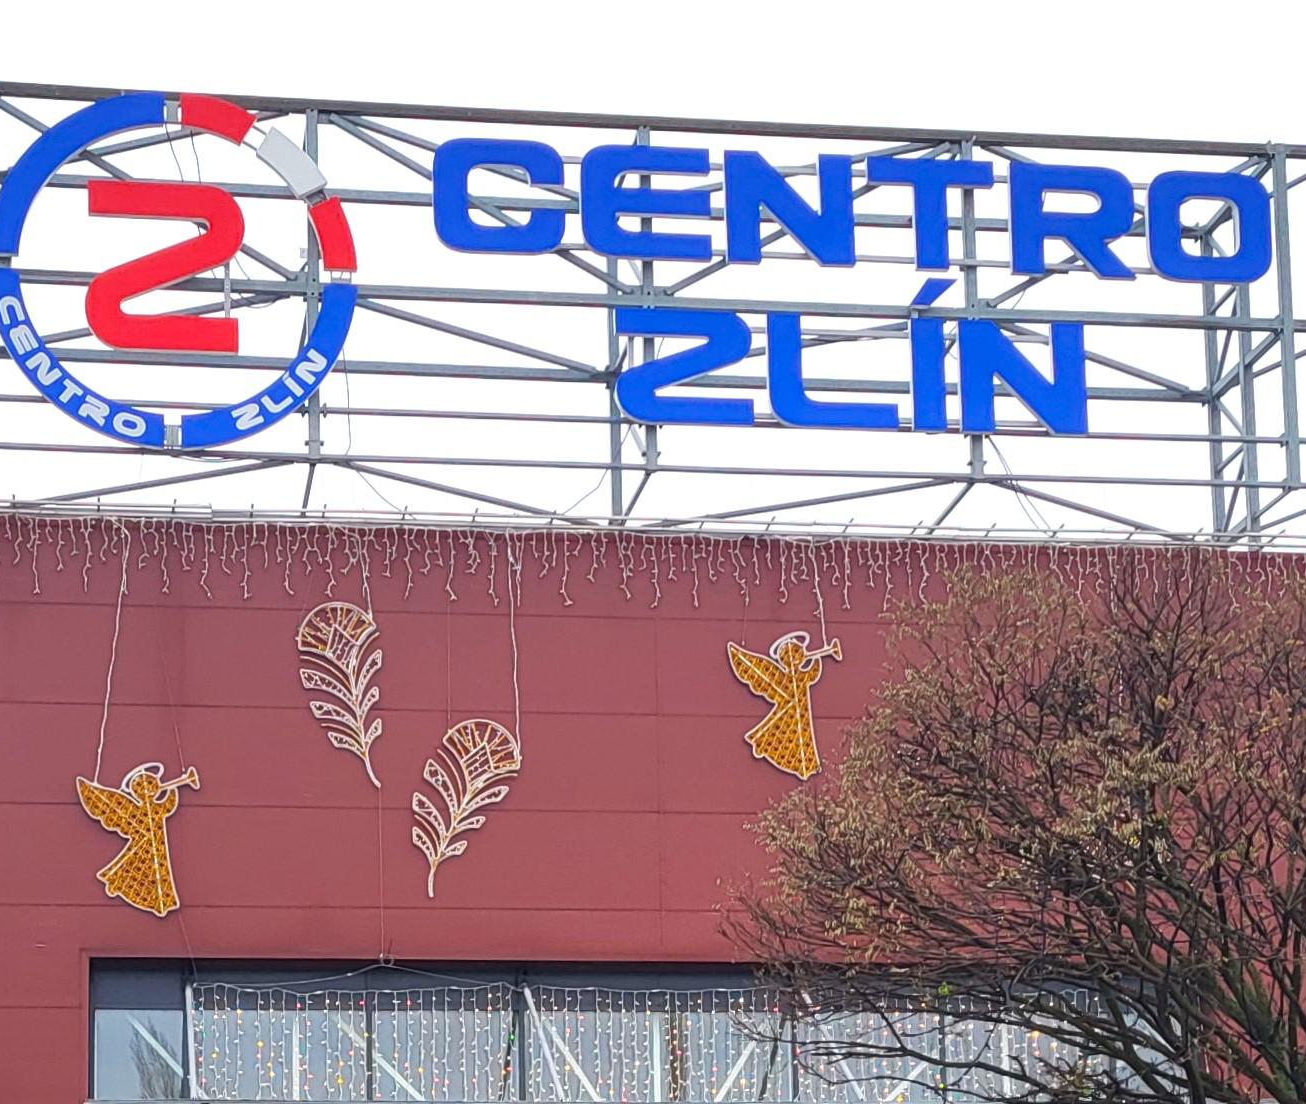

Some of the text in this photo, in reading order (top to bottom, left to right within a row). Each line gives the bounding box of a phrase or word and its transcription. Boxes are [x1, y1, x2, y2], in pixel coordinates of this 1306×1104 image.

[432, 137, 1273, 283] CENTRO
[231, 348, 328, 432] ZLÍN
[614, 277, 1089, 436] ZLÍN
